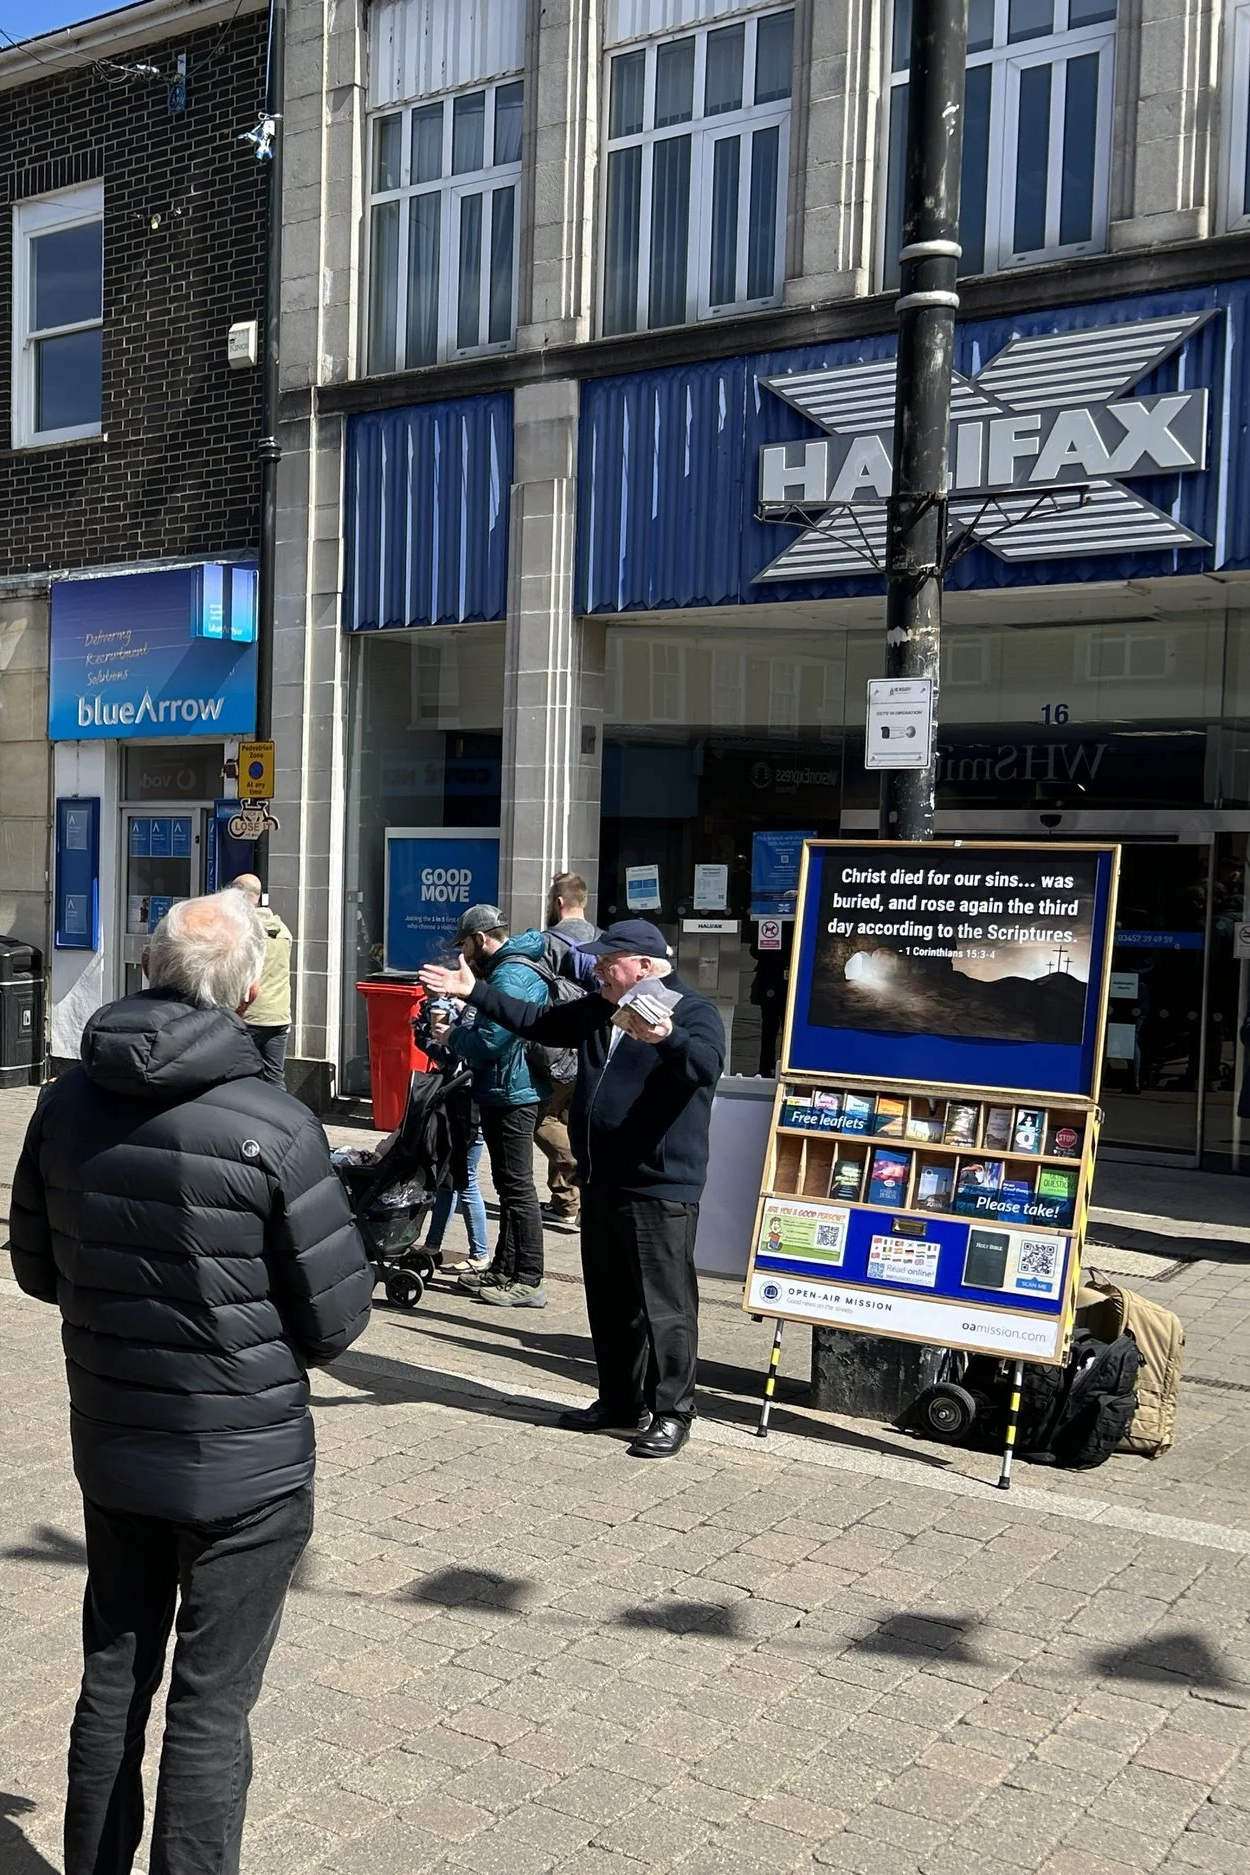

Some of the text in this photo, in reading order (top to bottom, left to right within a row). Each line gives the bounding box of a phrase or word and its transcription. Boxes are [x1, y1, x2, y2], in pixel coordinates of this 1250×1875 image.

[762, 395, 1195, 501] HAIFAX
[1041, 703, 1069, 725] 16
[235, 821, 260, 832] LOSE
[421, 868, 472, 885] GOOD
[841, 868, 1074, 889] Christ died for our sins... was
[421, 885, 469, 902] MOVE
[833, 893, 1079, 917] buried, and rose again the third
[827, 918, 1078, 944] day according to the Scriptures.
[905, 947, 910, 956] 1
[913, 947, 963, 958] Corinthians
[966, 949, 996, 959] 15:3-4
[791, 1111, 865, 1129] Free leaflets
[1058, 1134, 1076, 1142] STOP
[781, 1207, 792, 1215] YOU
[798, 1209, 817, 1217] GOOD
[976, 1196, 1060, 1219] Please take!
[887, 1264, 934, 1277] Read online!
[1021, 1281, 1047, 1290] SCAN ME
[788, 1287, 841, 1303] OPEN-AIR
[845, 1297, 892, 1312] MISSION
[962, 1322, 1046, 1342] oamission.com
